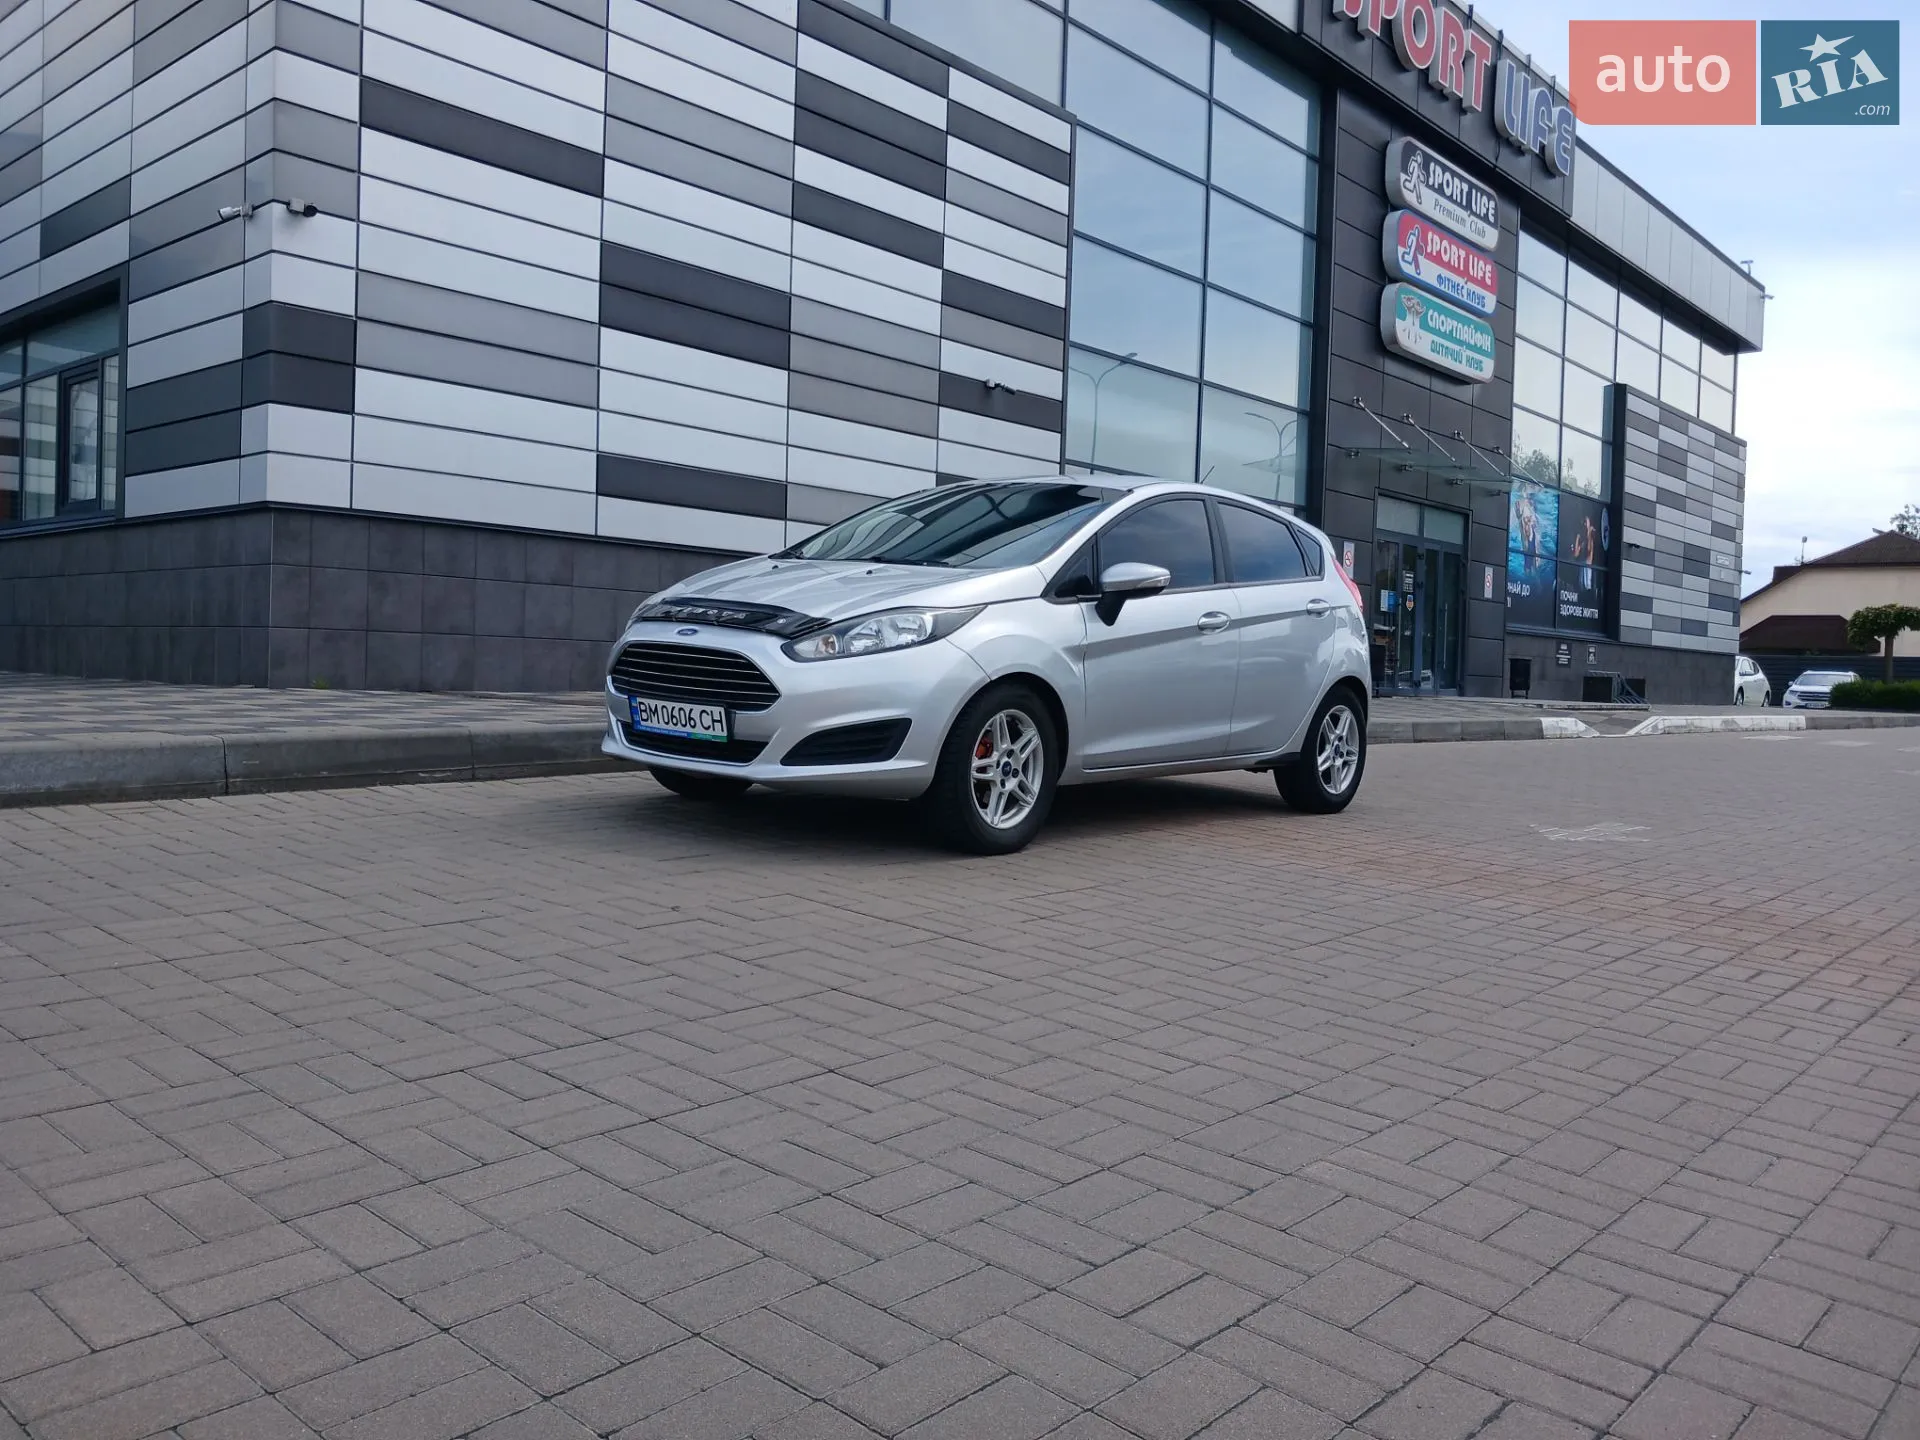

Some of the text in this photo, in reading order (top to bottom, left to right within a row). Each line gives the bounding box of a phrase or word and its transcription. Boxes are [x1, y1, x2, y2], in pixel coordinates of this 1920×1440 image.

[1502, 58, 1574, 177] LIFE
[1428, 161, 1496, 223] SPORT LIFE
[1433, 198, 1487, 239] Premium Club
[1426, 231, 1493, 286] SPORT LIFE
[1436, 272, 1487, 308] ФІТНЕС КЛУБ
[1430, 339, 1484, 373] ДИТЯЧИЙ КЛУБ
[1560, 590, 1578, 602] ПОЧНИ
[1560, 604, 1598, 619] ЗДОРОВЕ ЖИТТЯ
[638, 701, 660, 724] BM
[660, 704, 697, 729] 0606
[699, 709, 725, 732] CH
